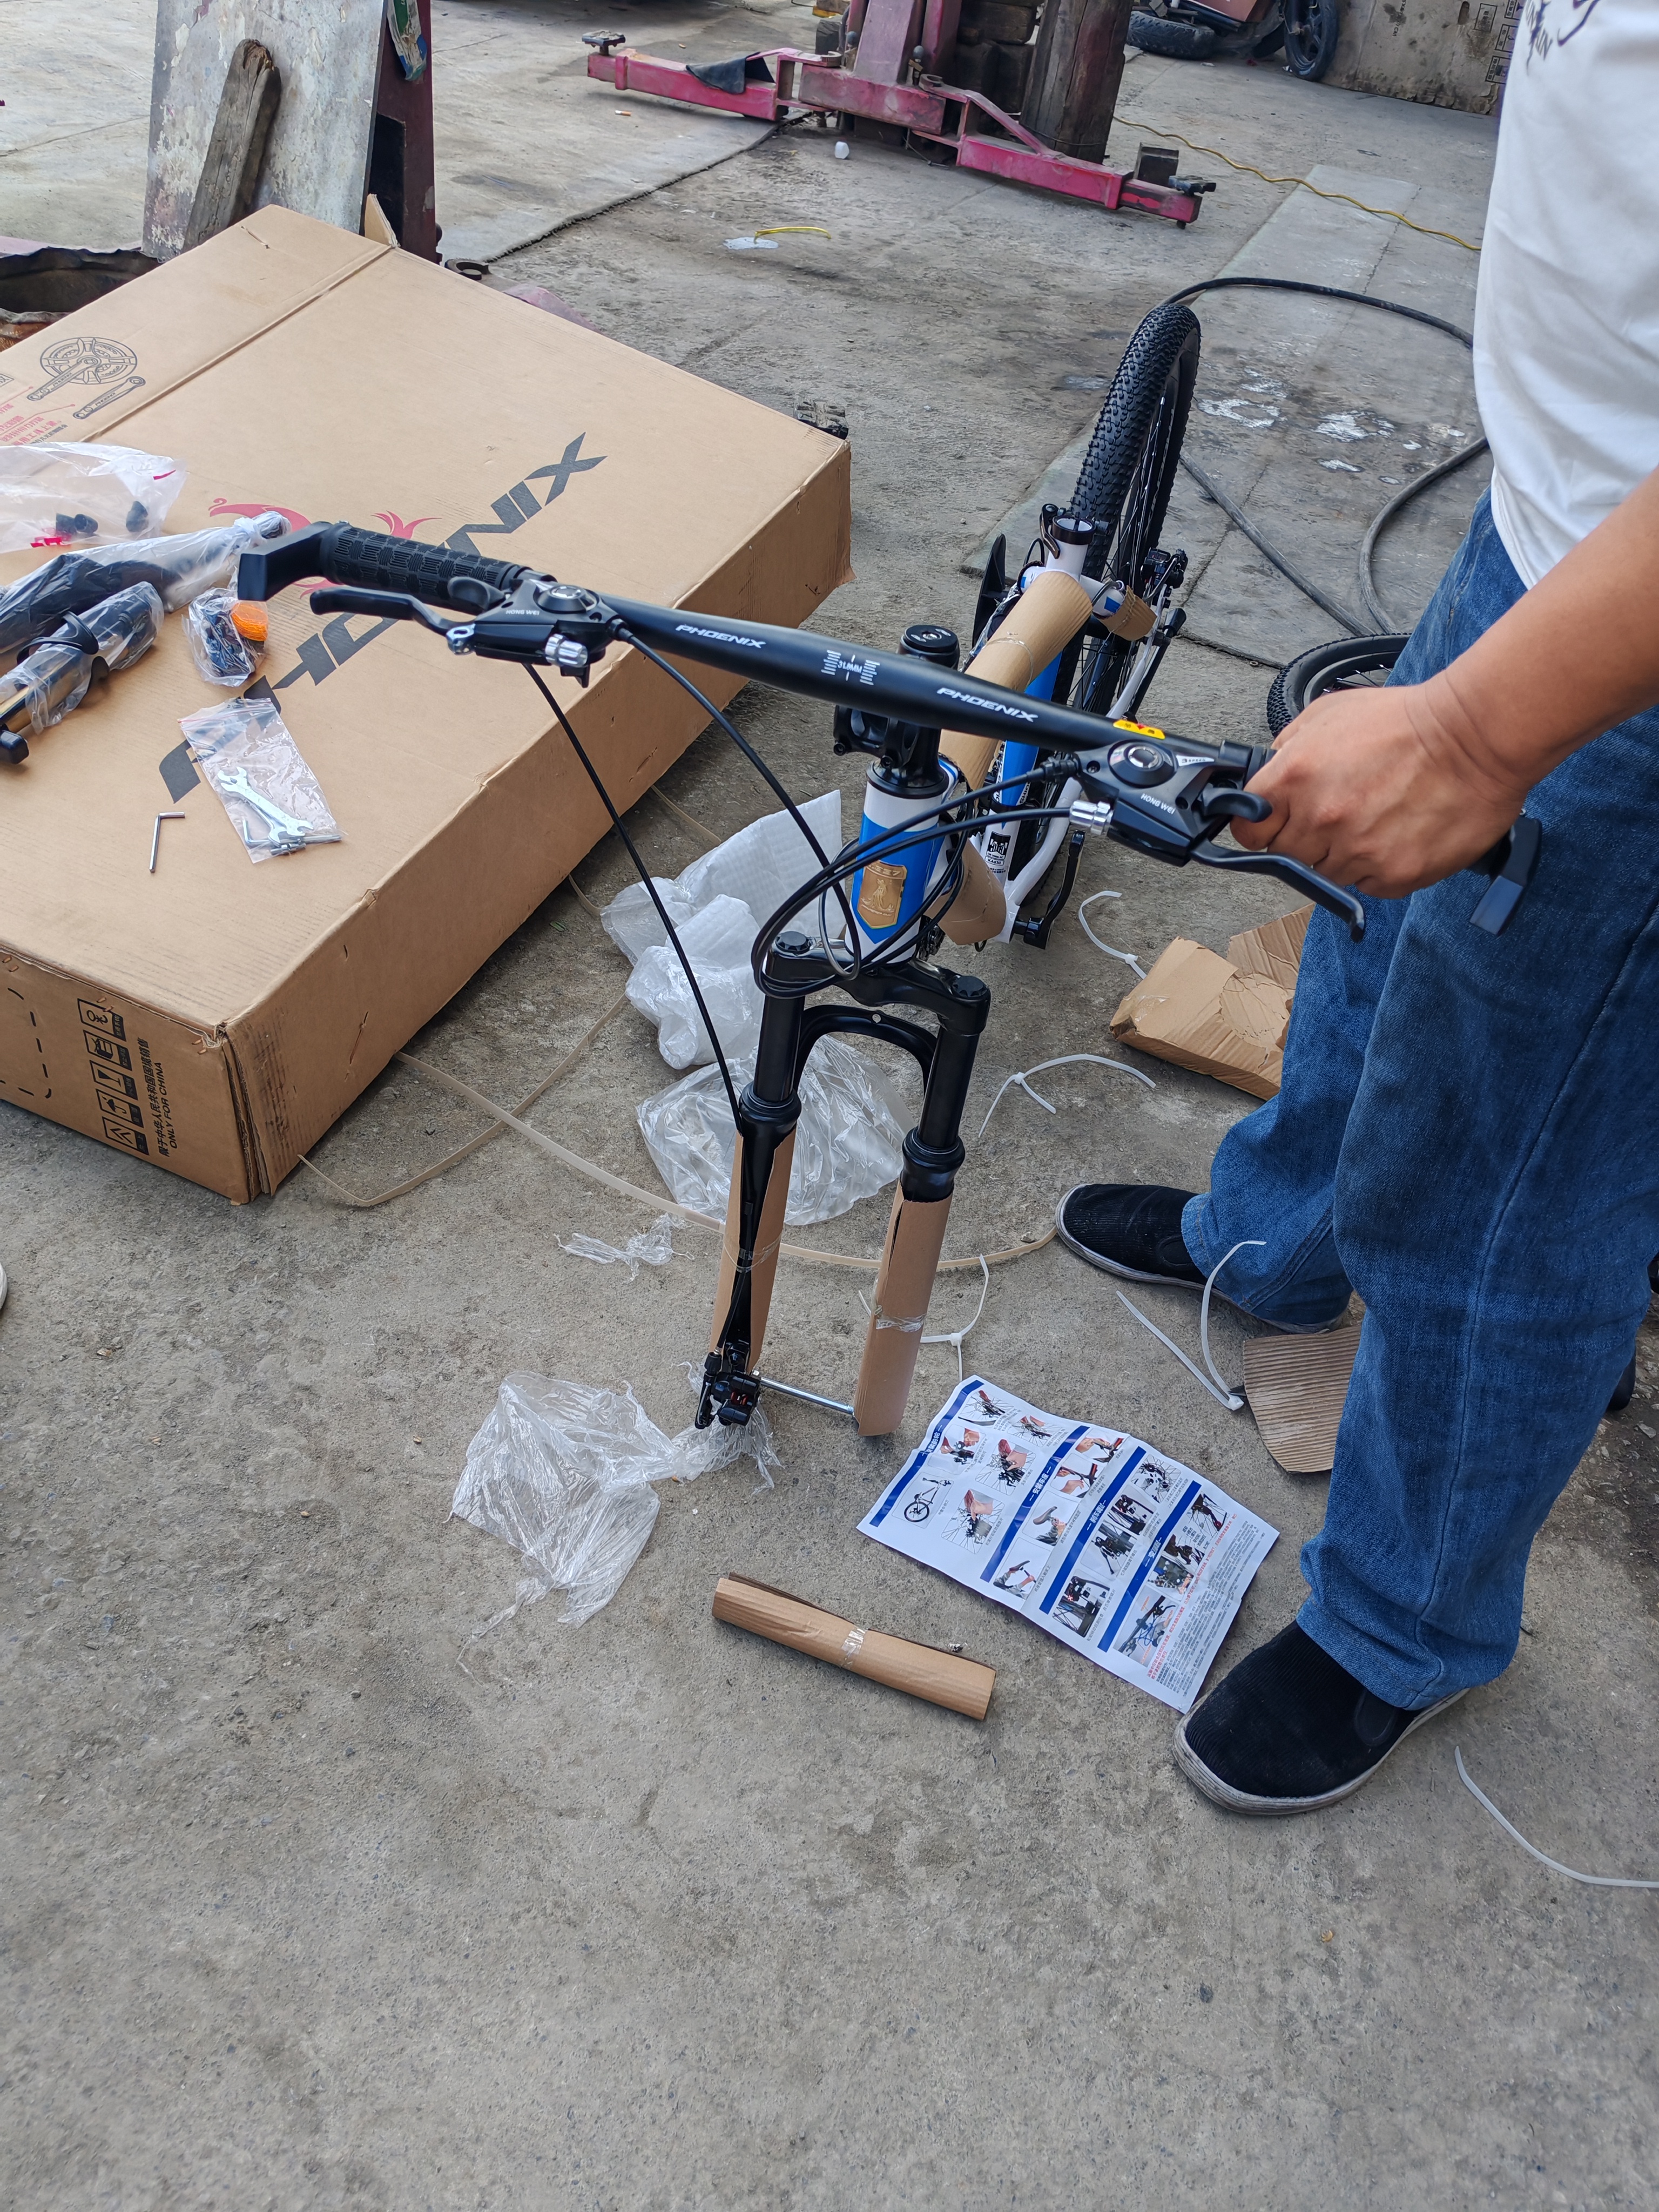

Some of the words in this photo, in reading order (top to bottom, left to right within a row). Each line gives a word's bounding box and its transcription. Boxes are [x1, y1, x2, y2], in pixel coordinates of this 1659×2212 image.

[159, 431, 608, 803] PHONIX
[676, 624, 766, 649] PHOENIX
[936, 687, 1038, 723] PHOENIX
[1141, 793, 1161, 807] HONG
[1161, 801, 1176, 814] WEI
[154, 1062, 167, 1096] CHINA
[161, 1097, 172, 1120] FOR
[166, 1121, 177, 1149] ONLY
